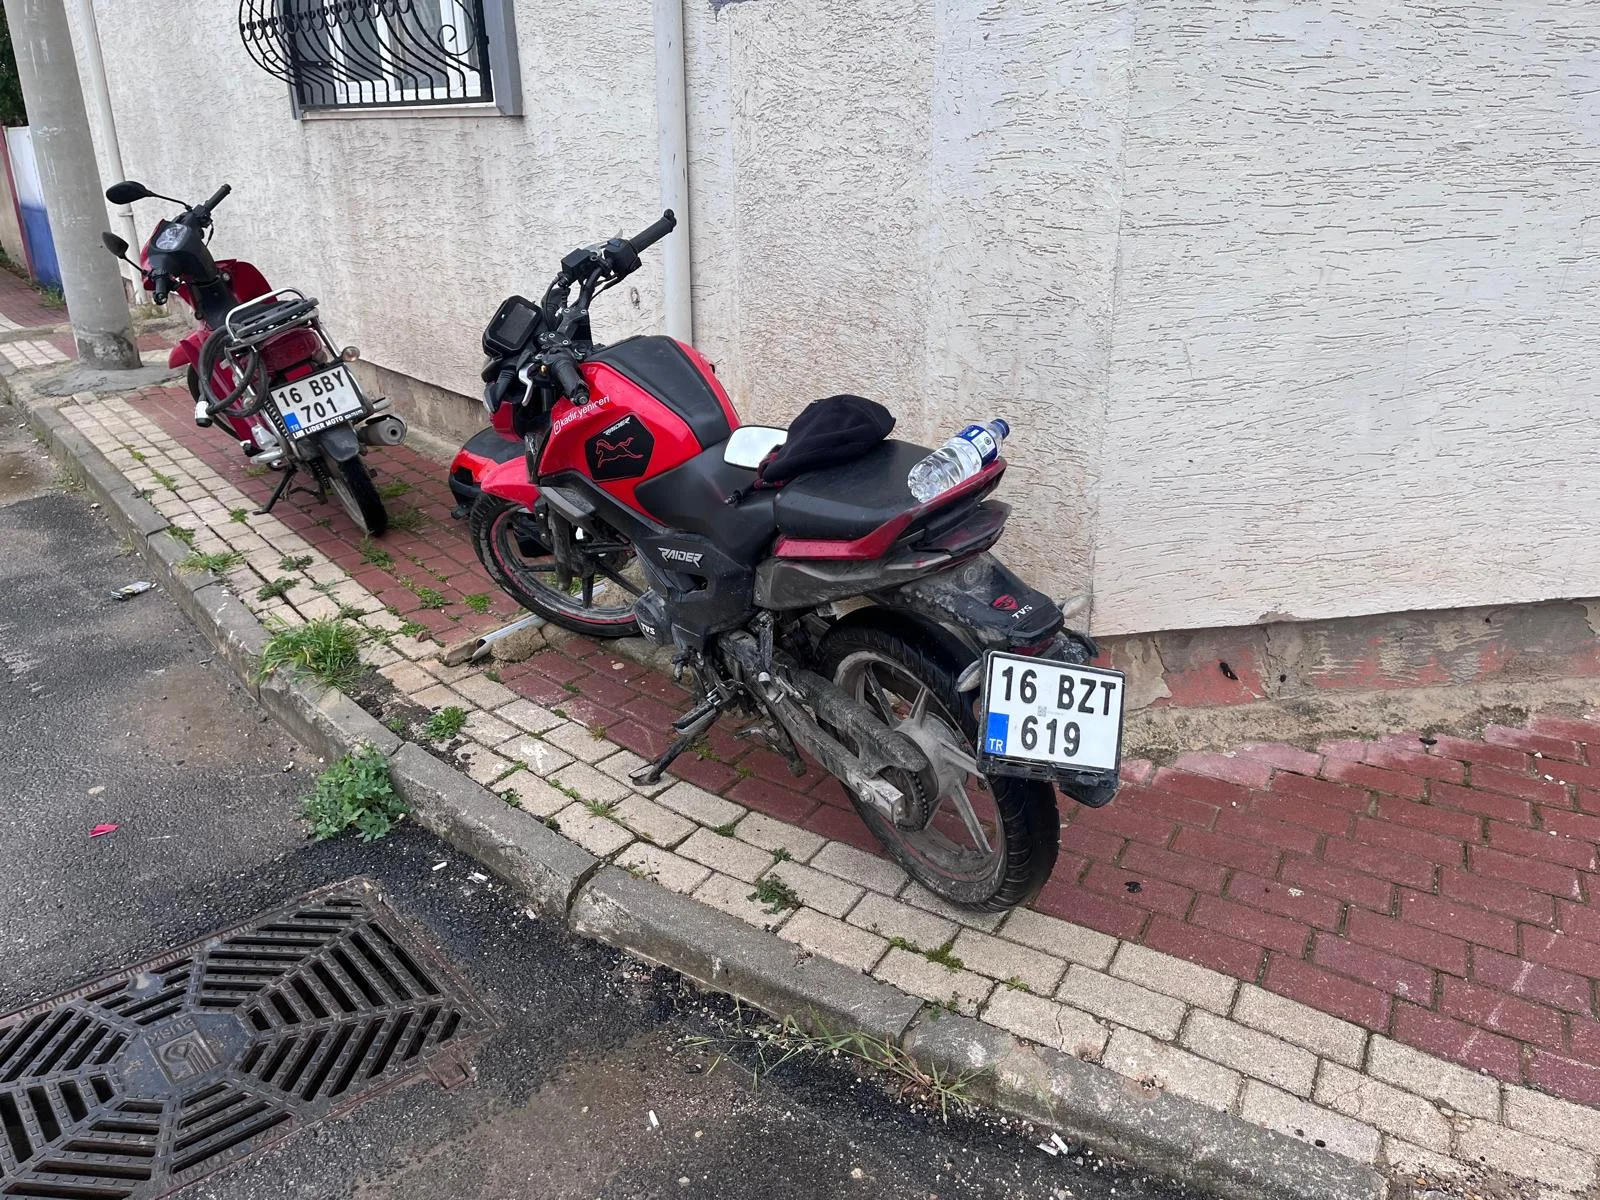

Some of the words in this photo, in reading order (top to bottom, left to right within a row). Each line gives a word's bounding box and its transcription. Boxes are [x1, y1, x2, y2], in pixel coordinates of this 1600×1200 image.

[278, 387, 303, 408] 16
[309, 370, 345, 397] BBY
[301, 397, 337, 423] 701
[290, 423, 300, 432] TR
[325, 415, 344, 427] MOTO
[657, 547, 704, 568] RAIDER
[1012, 604, 1033, 619] TVS
[640, 622, 656, 635] TVS
[1001, 666, 1037, 704] 16
[1056, 674, 1116, 716] BZT
[989, 738, 1003, 752] TR
[1020, 715, 1081, 757] 619
